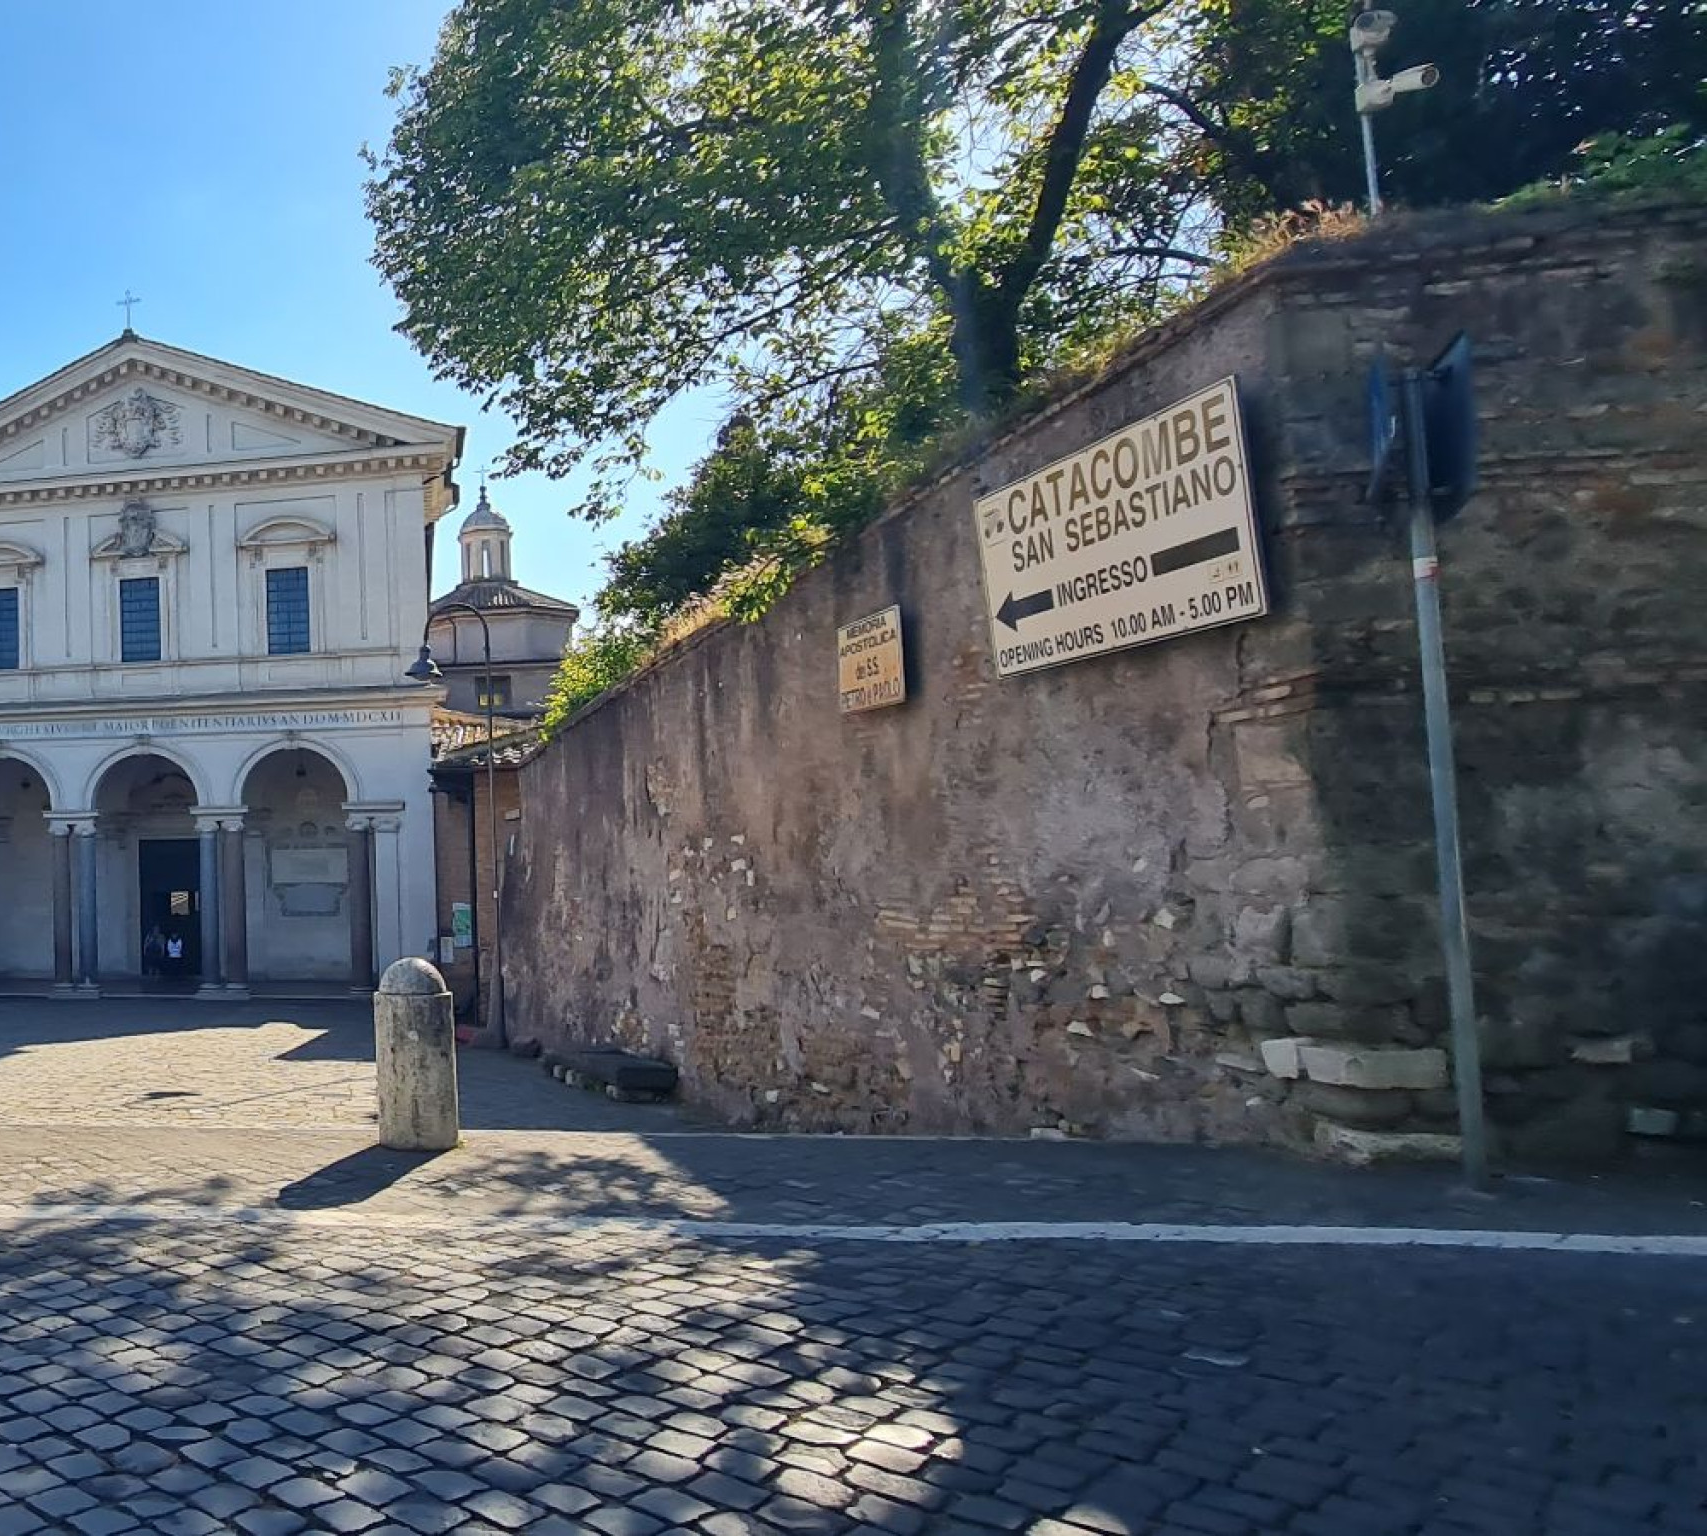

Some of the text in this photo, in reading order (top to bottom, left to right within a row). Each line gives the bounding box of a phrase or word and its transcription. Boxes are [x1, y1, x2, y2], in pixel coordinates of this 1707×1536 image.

[1008, 394, 1231, 534] CATACOMBE
[1011, 455, 1236, 572] SAN SEBASTIANO
[1056, 555, 1148, 607] INGRESSO
[839, 628, 897, 657] APOSTOLICA
[846, 615, 887, 640] MEMORIA
[999, 638, 1054, 669] OPENING
[1054, 623, 1105, 652] HOURS
[1111, 612, 1148, 639] 10.00
[1151, 603, 1176, 630] AM
[1189, 591, 1222, 618] 5.00
[1226, 581, 1254, 609] PM
